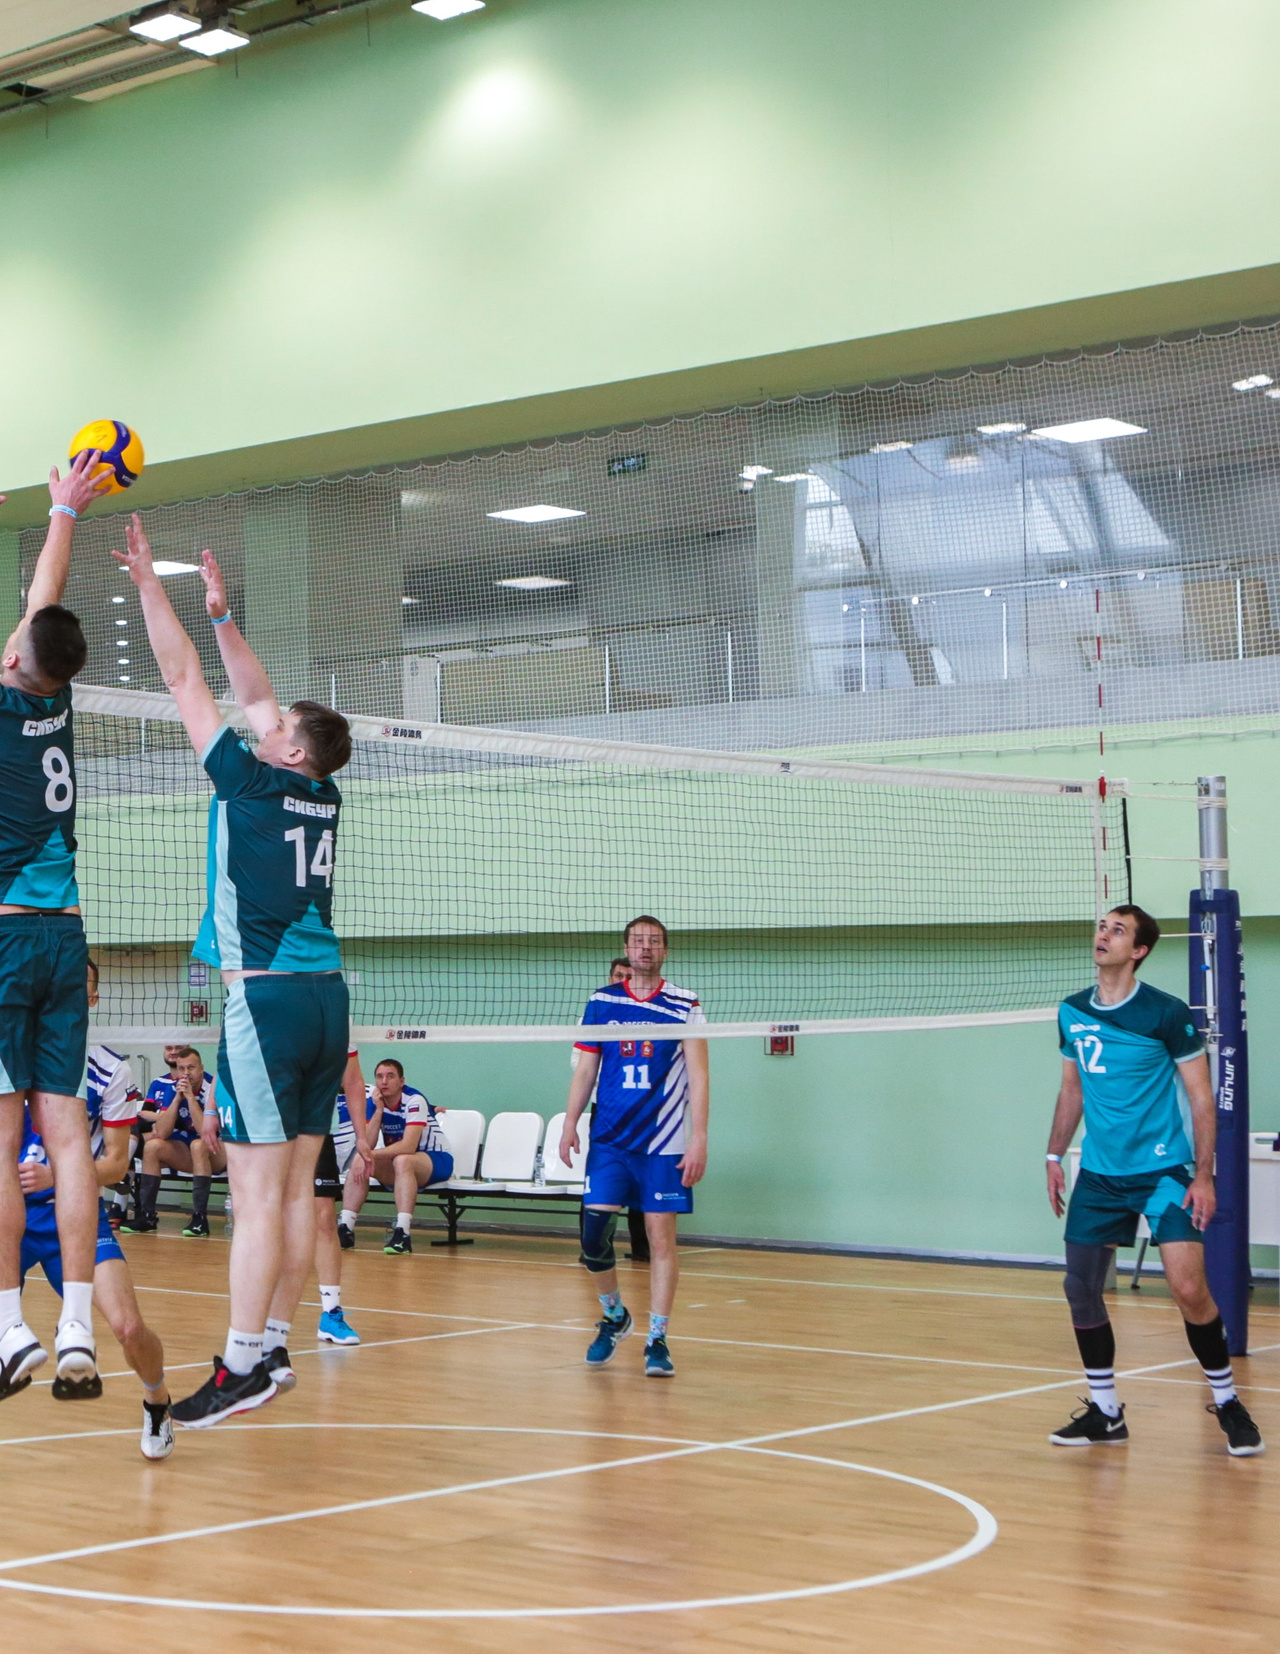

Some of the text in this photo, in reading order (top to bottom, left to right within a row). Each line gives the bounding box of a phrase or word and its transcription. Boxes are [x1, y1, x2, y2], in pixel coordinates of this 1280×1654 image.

[42, 746, 73, 812] 8
[283, 795, 336, 819] СИБУР
[284, 826, 333, 888] 14
[1074, 1035, 1107, 1074] 12
[622, 1064, 651, 1089] 11
[218, 1105, 233, 1128] 14
